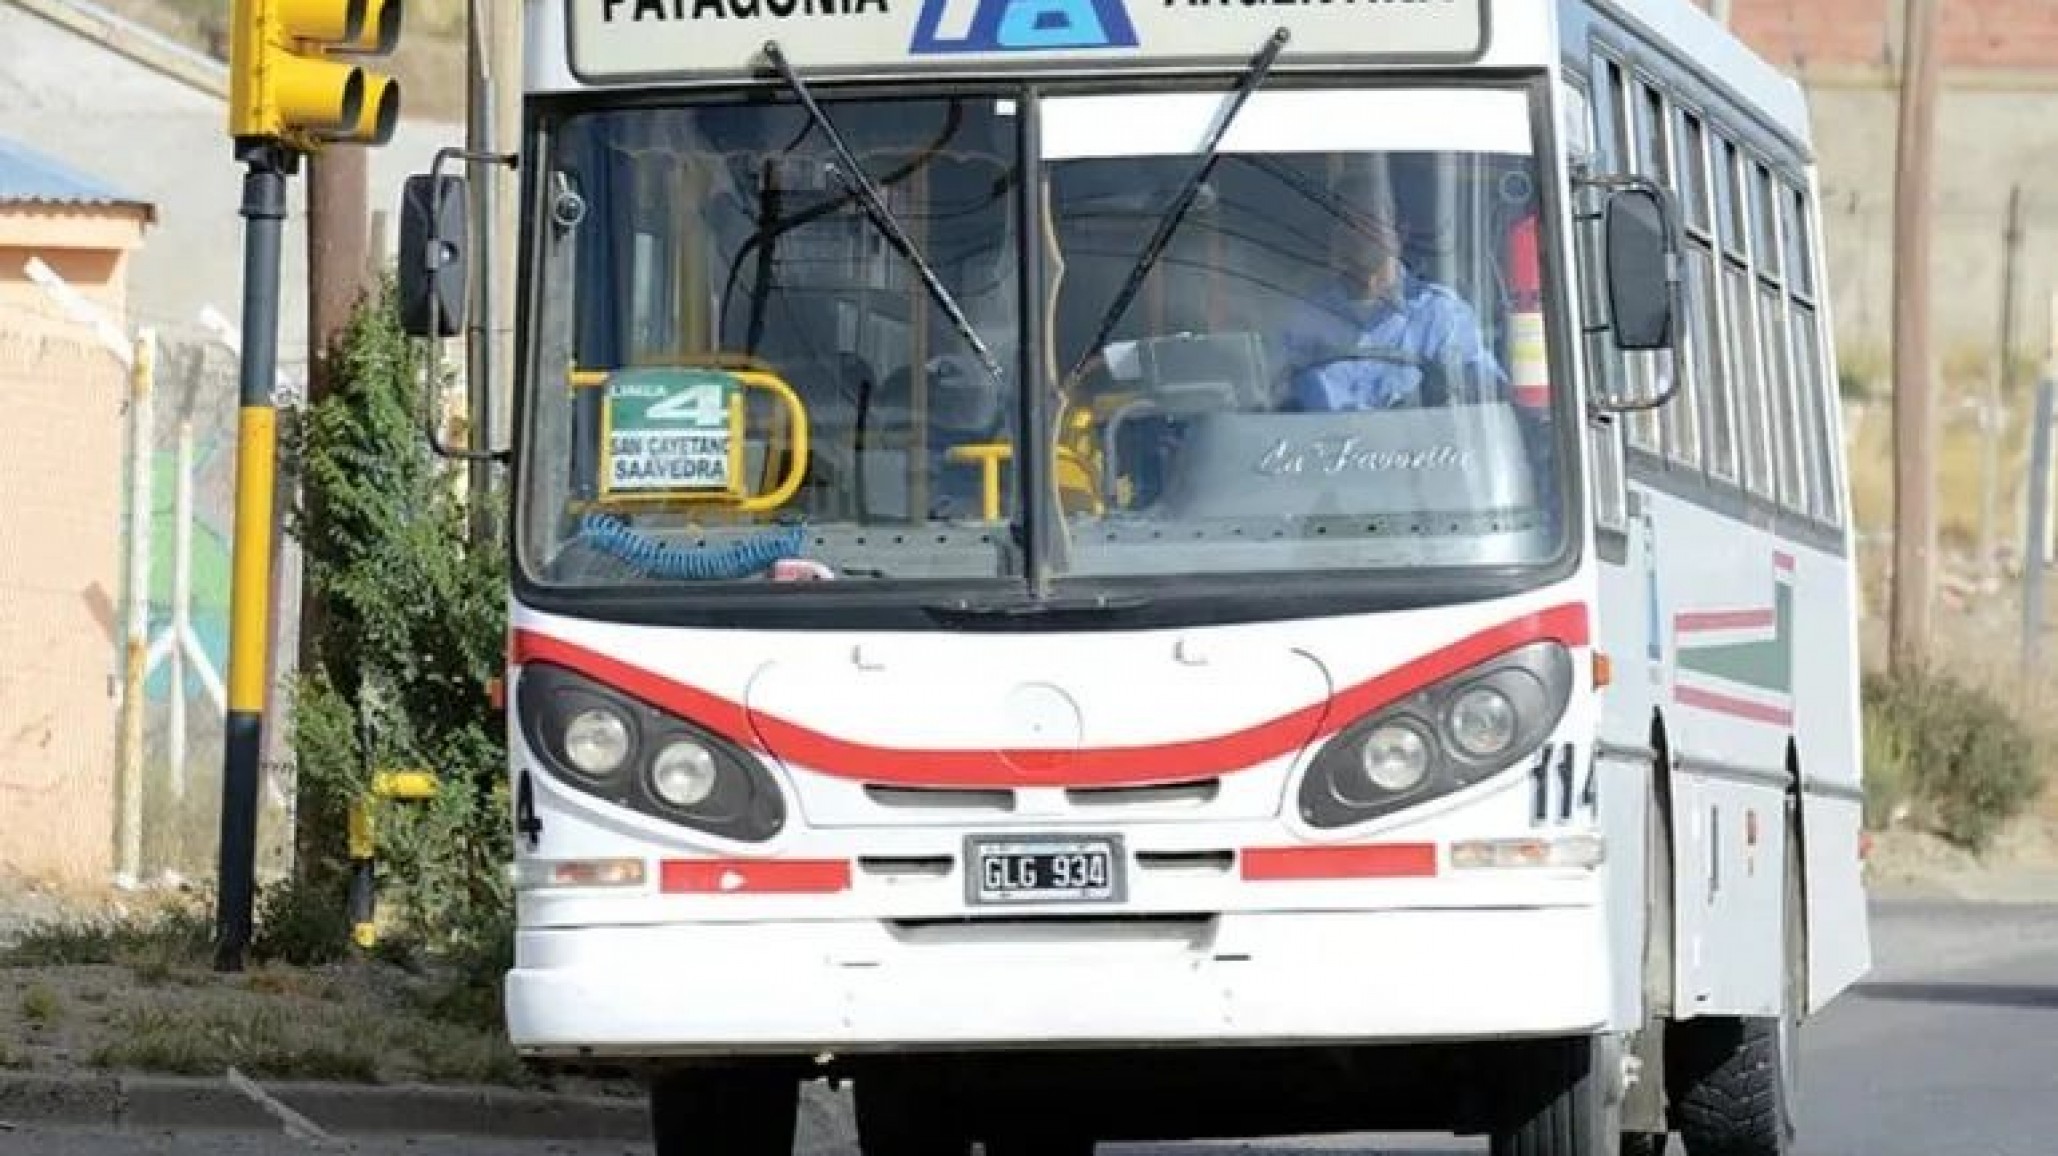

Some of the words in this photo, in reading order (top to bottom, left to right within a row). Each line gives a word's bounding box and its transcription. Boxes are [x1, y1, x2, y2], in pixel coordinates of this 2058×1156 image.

[645, 384, 730, 426] 4
[611, 436, 643, 455] SAN
[614, 458, 726, 480] SAAVEDRA
[985, 857, 1038, 888] GLG
[1053, 855, 1106, 887] 934
